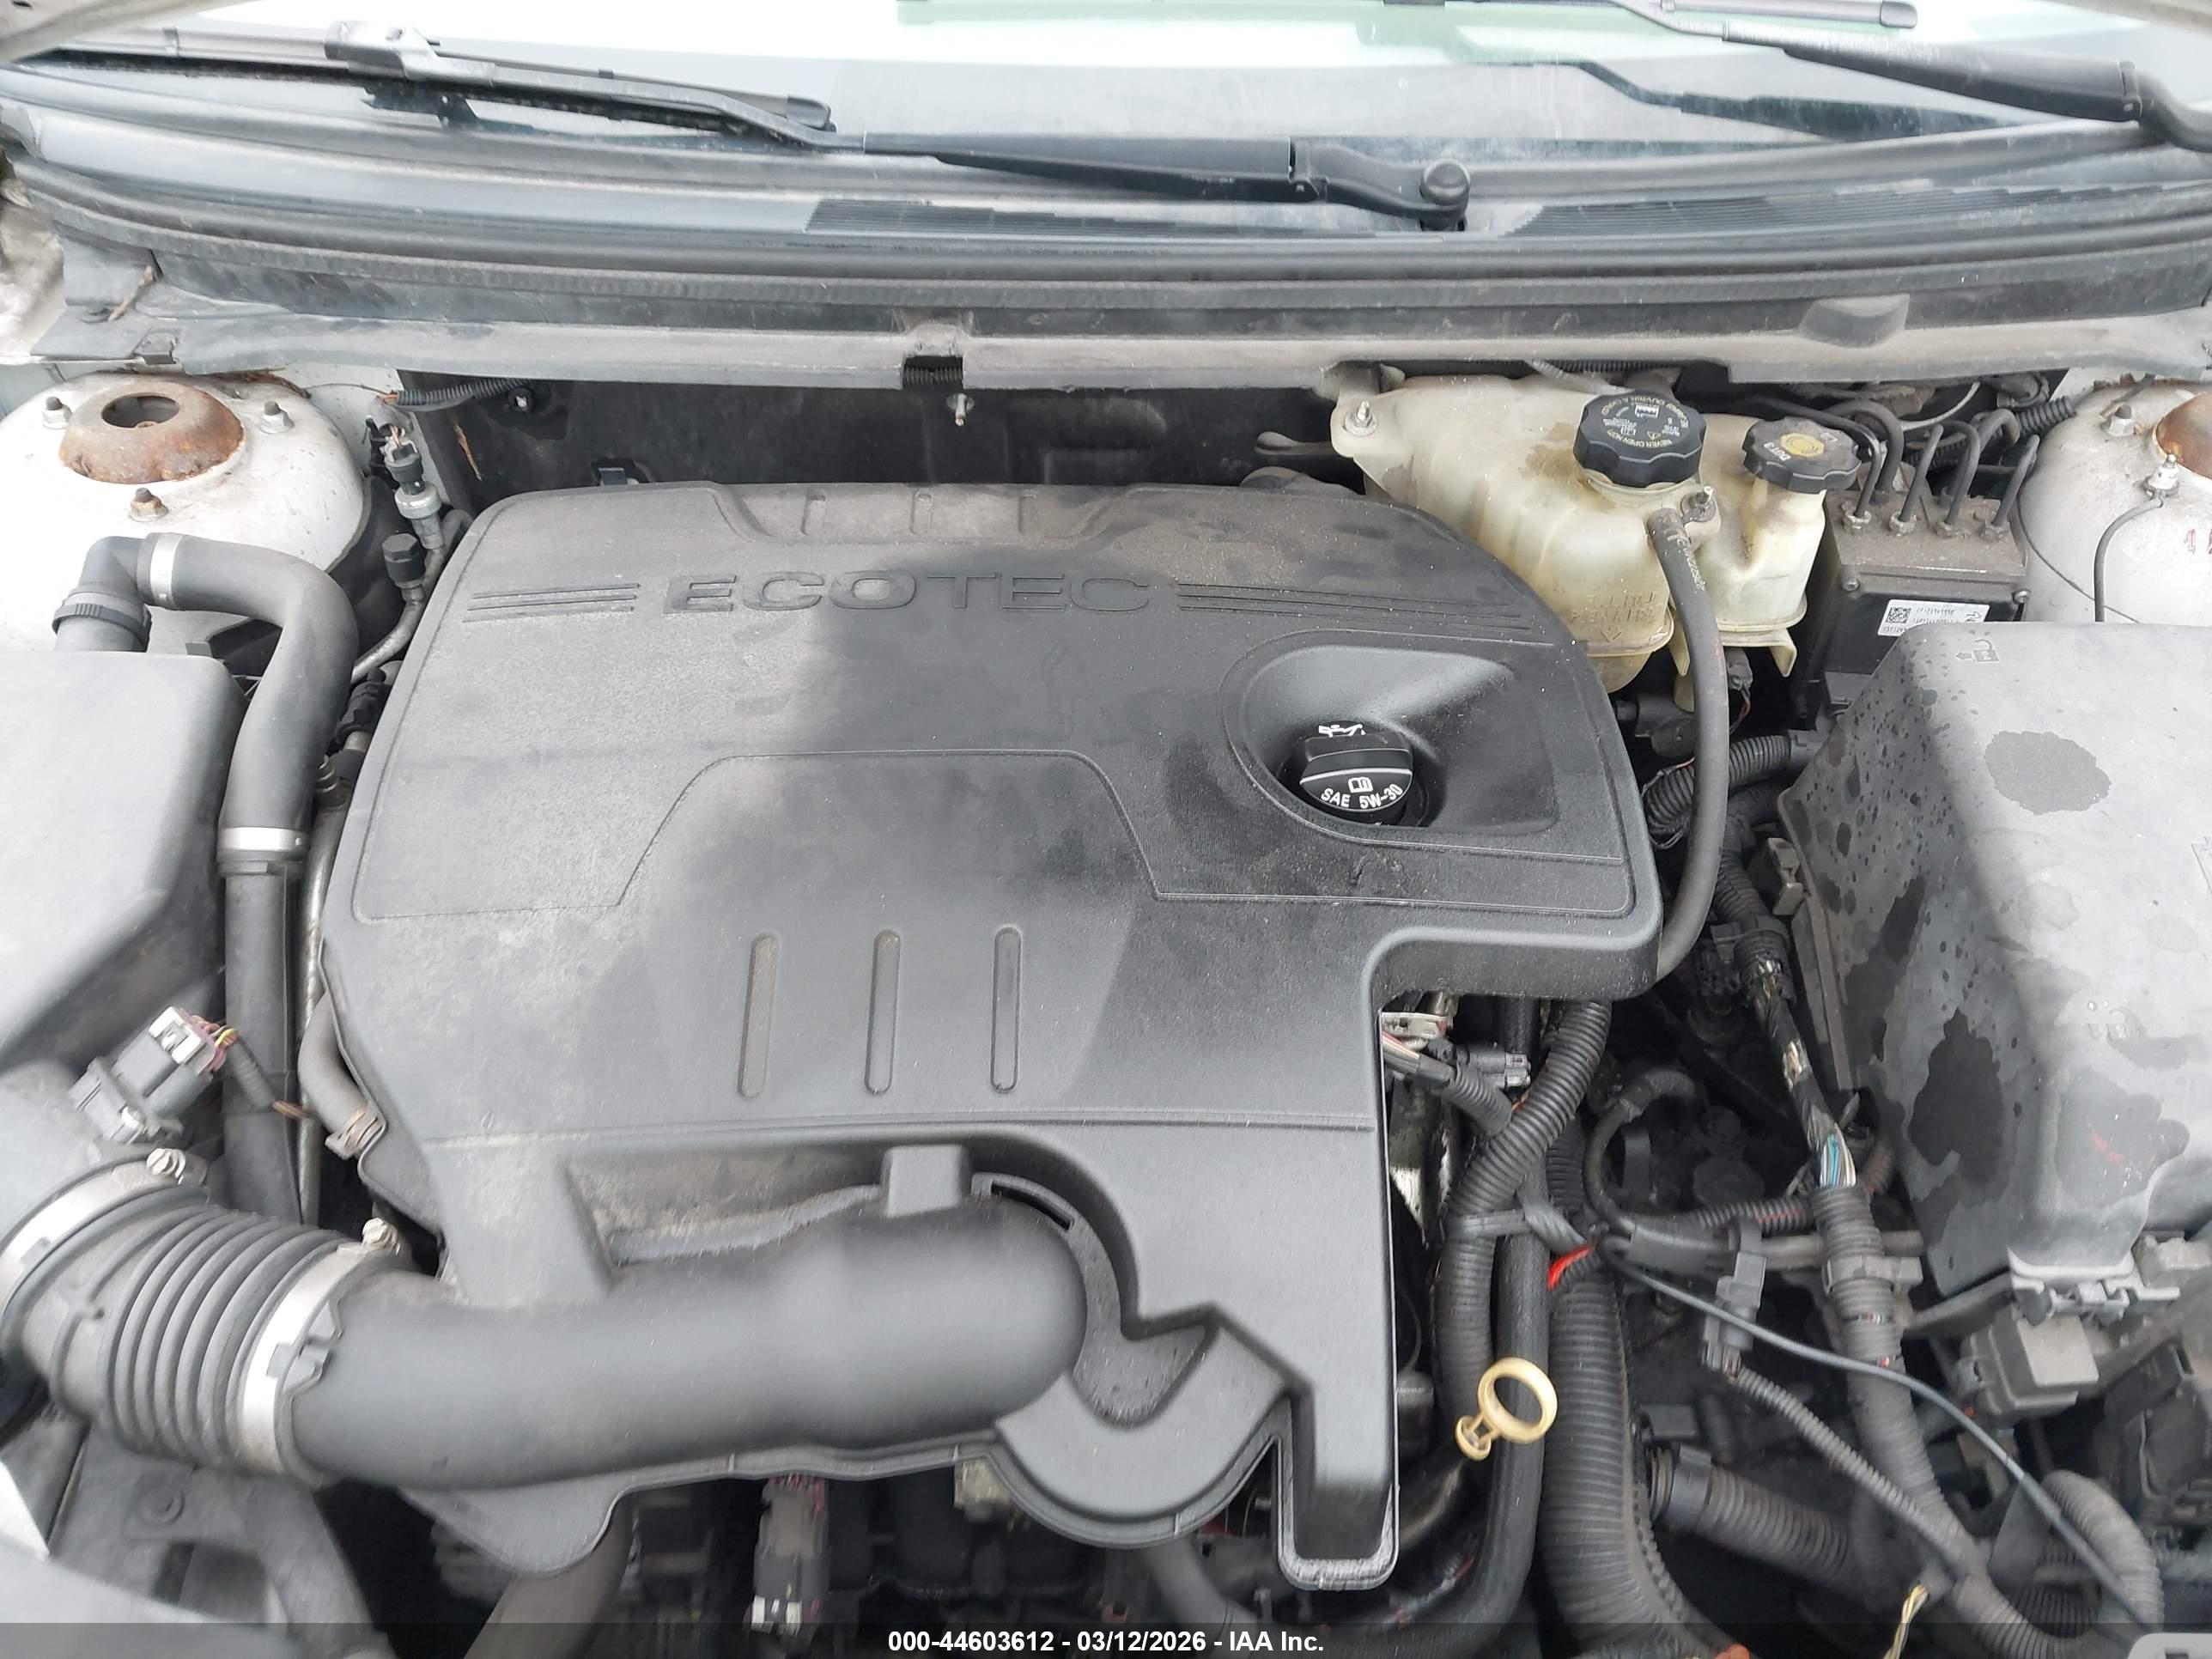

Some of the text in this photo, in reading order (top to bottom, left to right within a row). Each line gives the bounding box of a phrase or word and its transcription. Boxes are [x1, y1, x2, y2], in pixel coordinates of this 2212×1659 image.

[1623, 436, 1645, 447] OPEN
[1645, 439, 1673, 448] NEVER
[663, 571, 1150, 613] ECOTEC
[1321, 783, 1403, 810] SAE 5W-30
